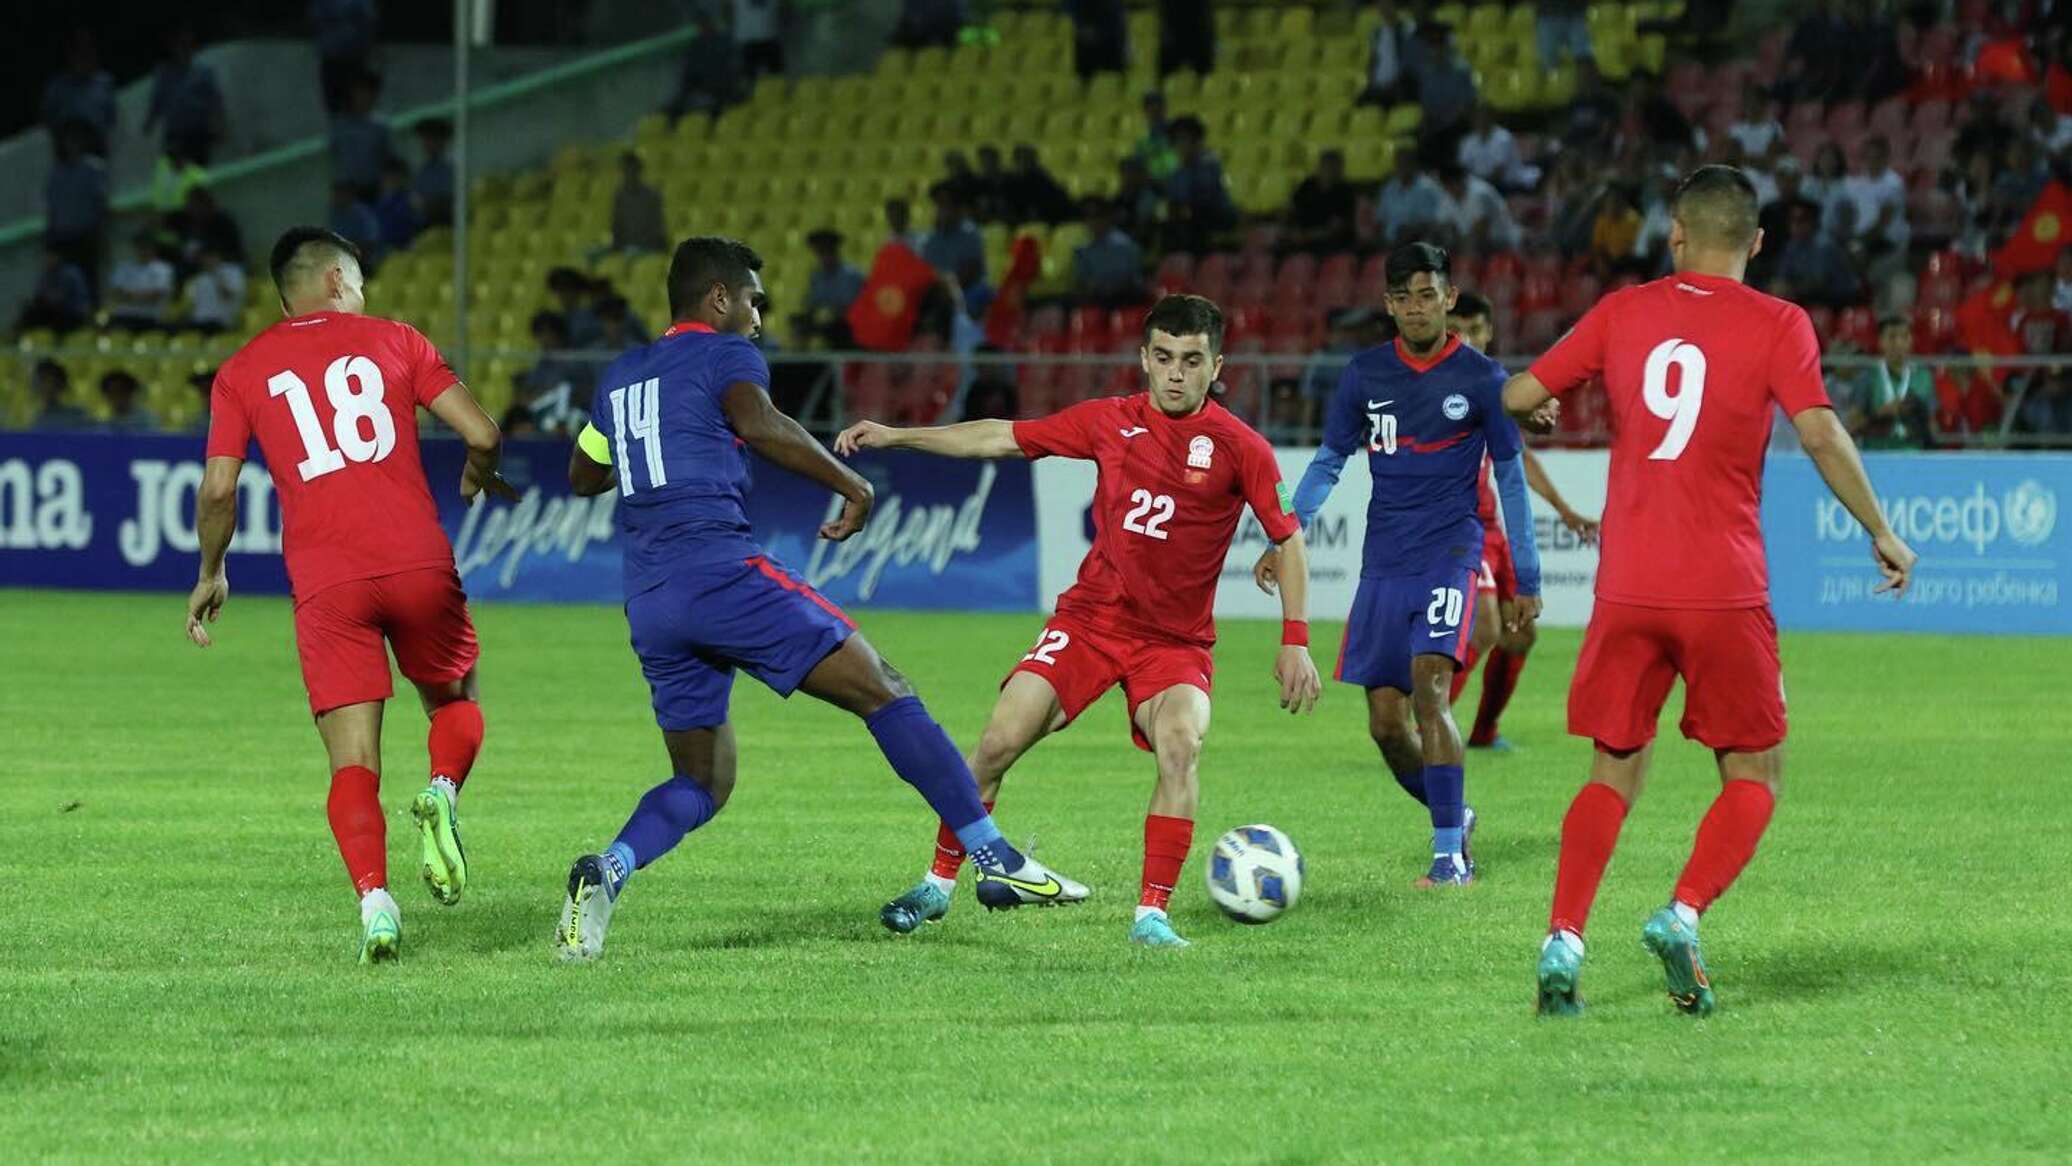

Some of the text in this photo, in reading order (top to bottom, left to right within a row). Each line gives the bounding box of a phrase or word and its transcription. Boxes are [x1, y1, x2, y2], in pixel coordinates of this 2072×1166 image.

[267, 355, 397, 483] 18
[1366, 413, 1398, 455] 20
[1643, 337, 1707, 461] 9
[609, 378, 668, 498] 14
[1122, 488, 1176, 541] 22
[1816, 480, 2001, 556] юисеф
[1427, 587, 1463, 627] 20
